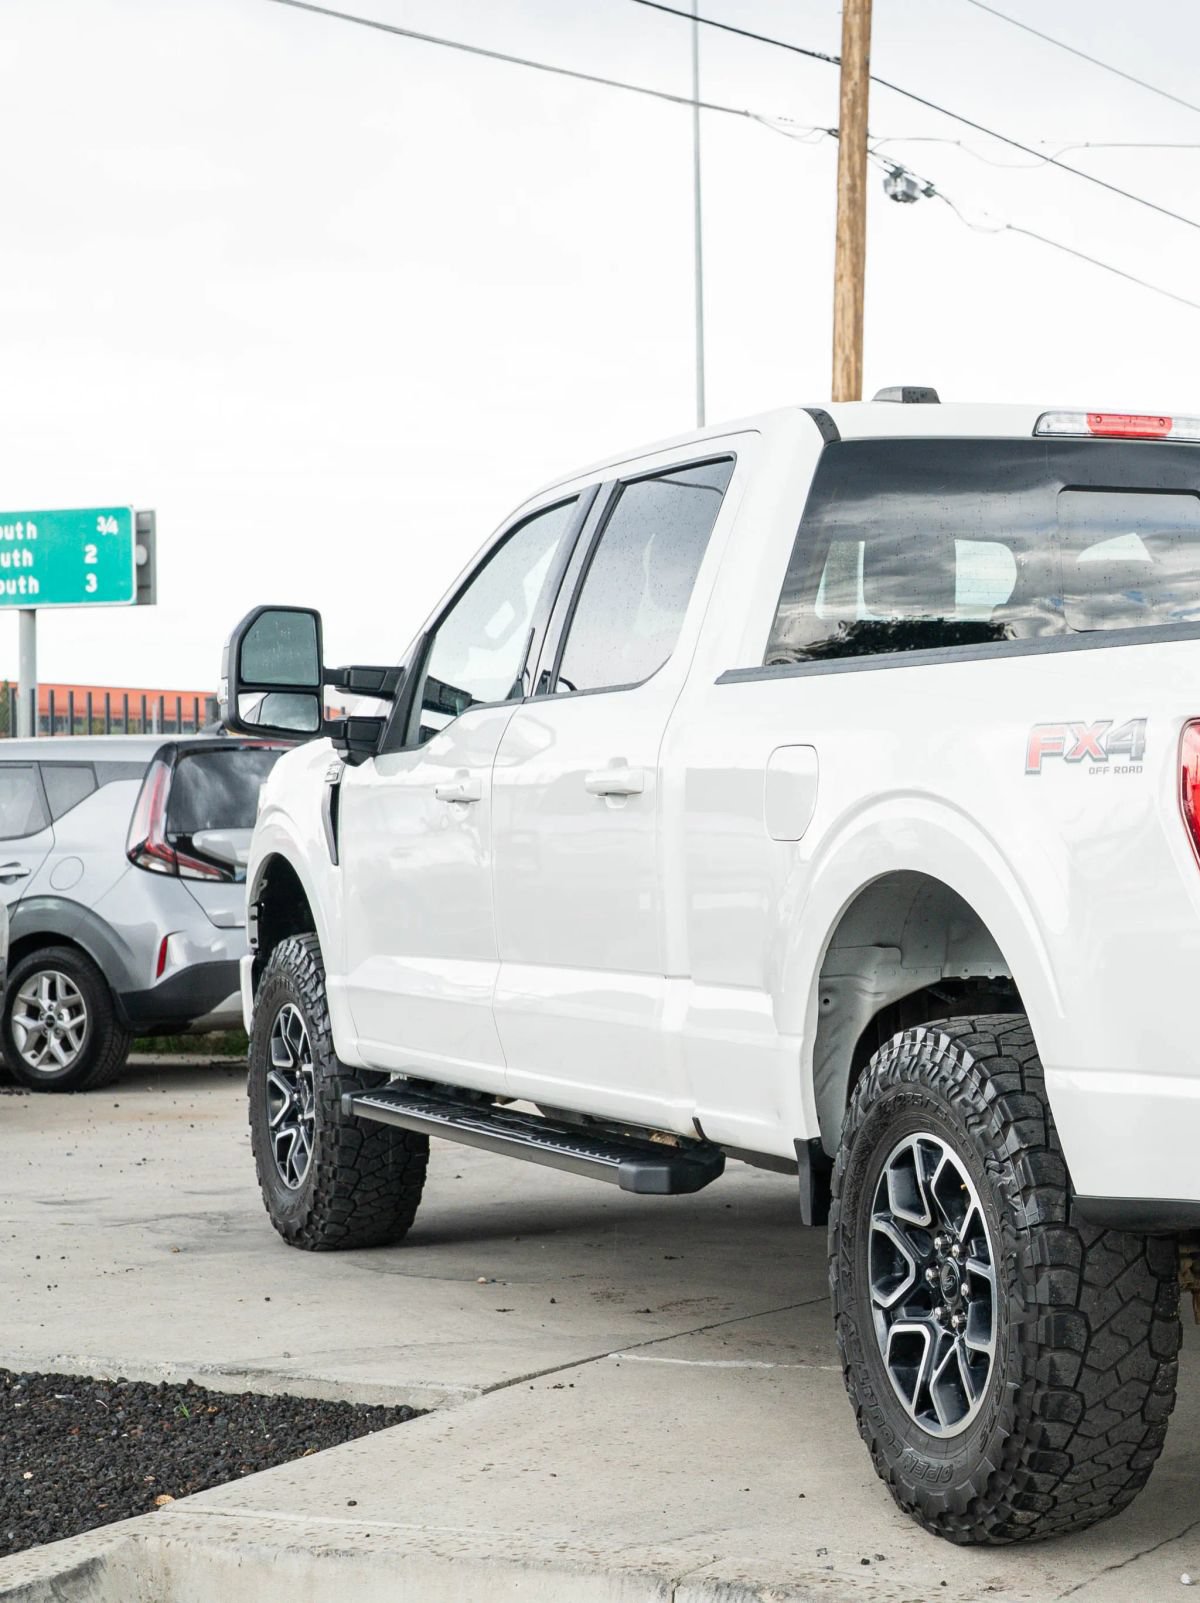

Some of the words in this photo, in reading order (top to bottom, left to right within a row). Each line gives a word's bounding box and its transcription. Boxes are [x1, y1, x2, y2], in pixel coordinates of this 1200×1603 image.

[84, 544, 98, 564] 2
[85, 573, 97, 593] 3
[1025, 718, 1147, 775] FX4
[1088, 766, 1110, 775] OFF
[1113, 765, 1143, 774] ROAD
[901, 1452, 954, 1483] OPEN
